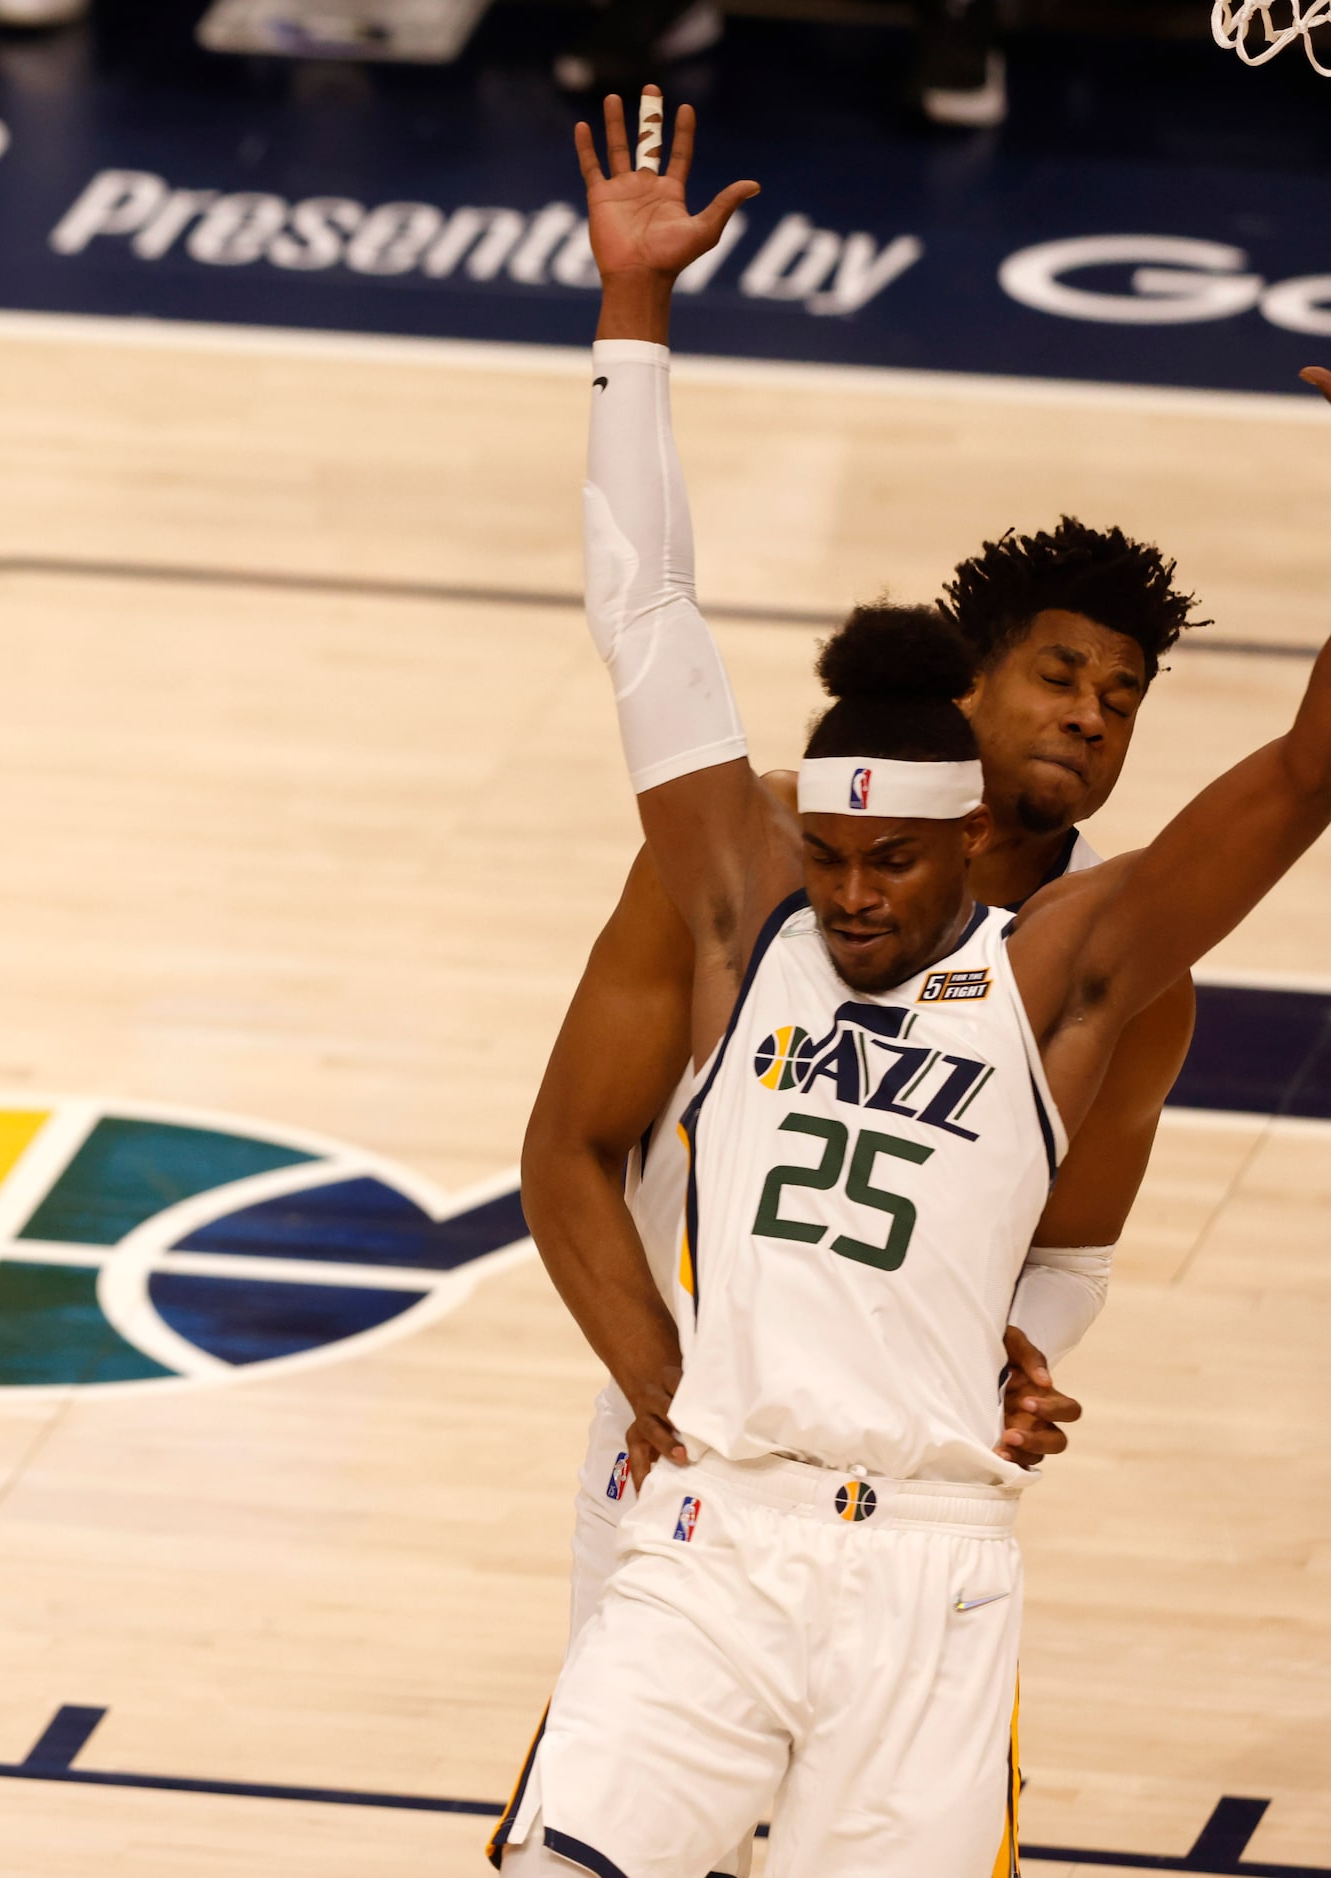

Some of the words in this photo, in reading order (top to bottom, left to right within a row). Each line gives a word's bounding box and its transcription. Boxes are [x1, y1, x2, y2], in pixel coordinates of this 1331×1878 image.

[740, 212, 923, 314] by
[923, 975, 946, 999] 5
[943, 984, 988, 999] FIGHT
[751, 1112, 936, 1272] 25
